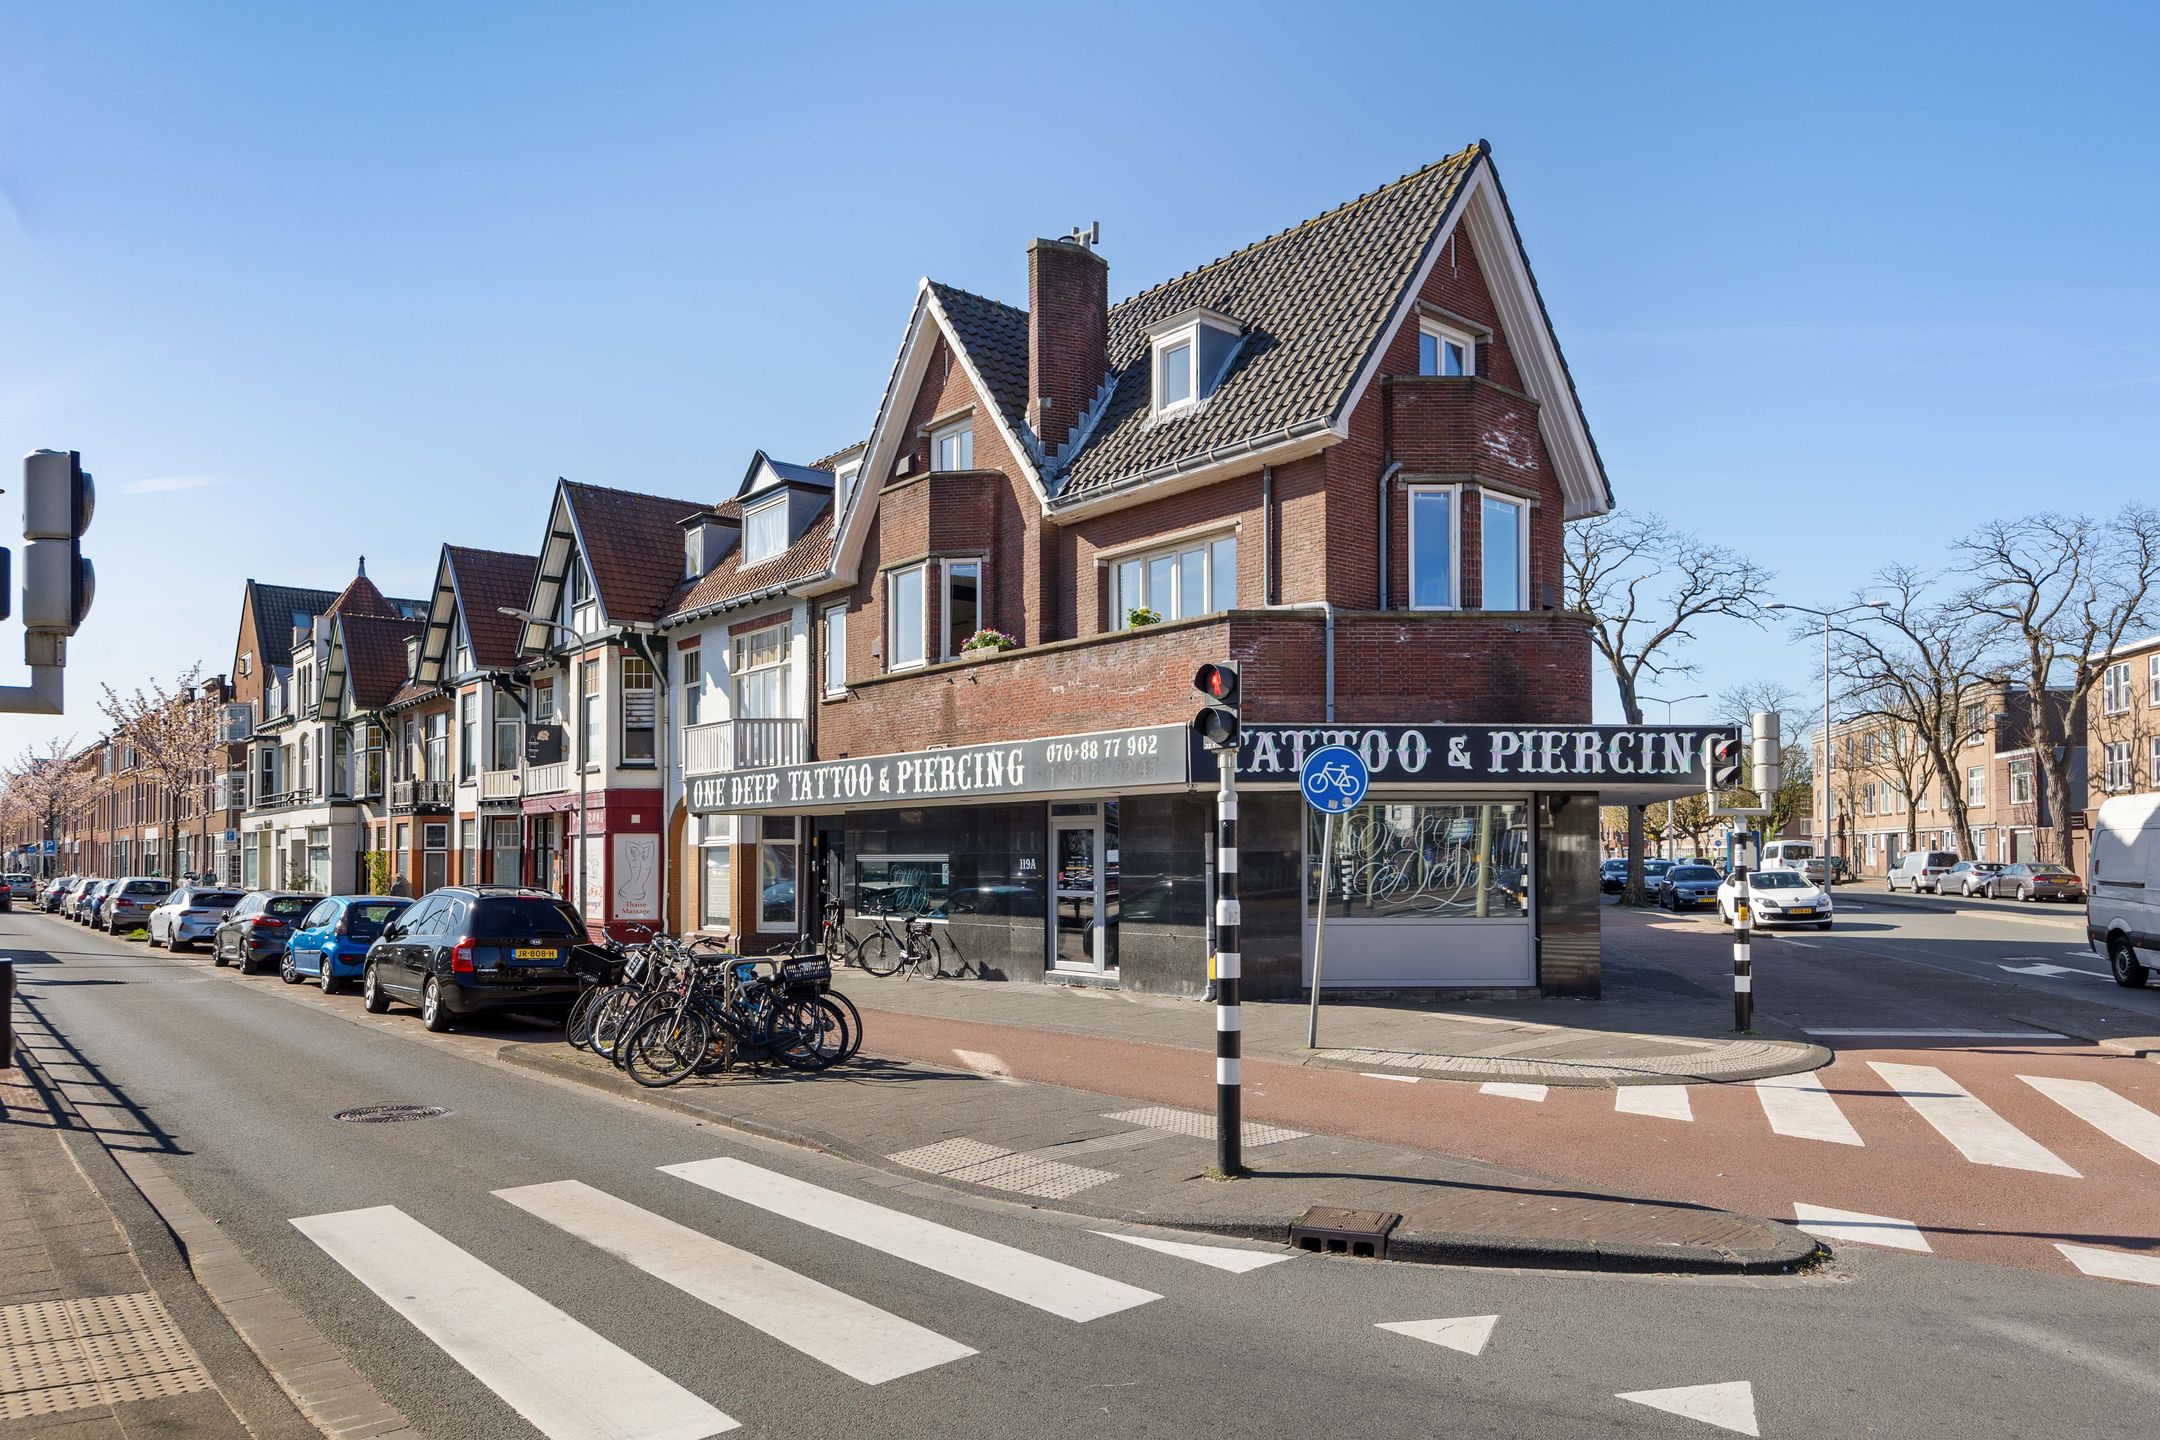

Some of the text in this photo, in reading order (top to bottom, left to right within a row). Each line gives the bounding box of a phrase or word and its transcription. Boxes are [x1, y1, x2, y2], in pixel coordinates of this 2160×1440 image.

[1104, 738, 1121, 757] 77
[1127, 735, 1158, 756] 902
[1448, 735, 1473, 770] &
[693, 777, 725, 808] ONE
[731, 773, 779, 805] DEEP
[788, 763, 873, 802] TATTOO
[879, 766, 890, 793] &
[897, 748, 1025, 794] PIERCING
[1019, 858, 1036, 870] 119A
[622, 908, 650, 916] Massage
